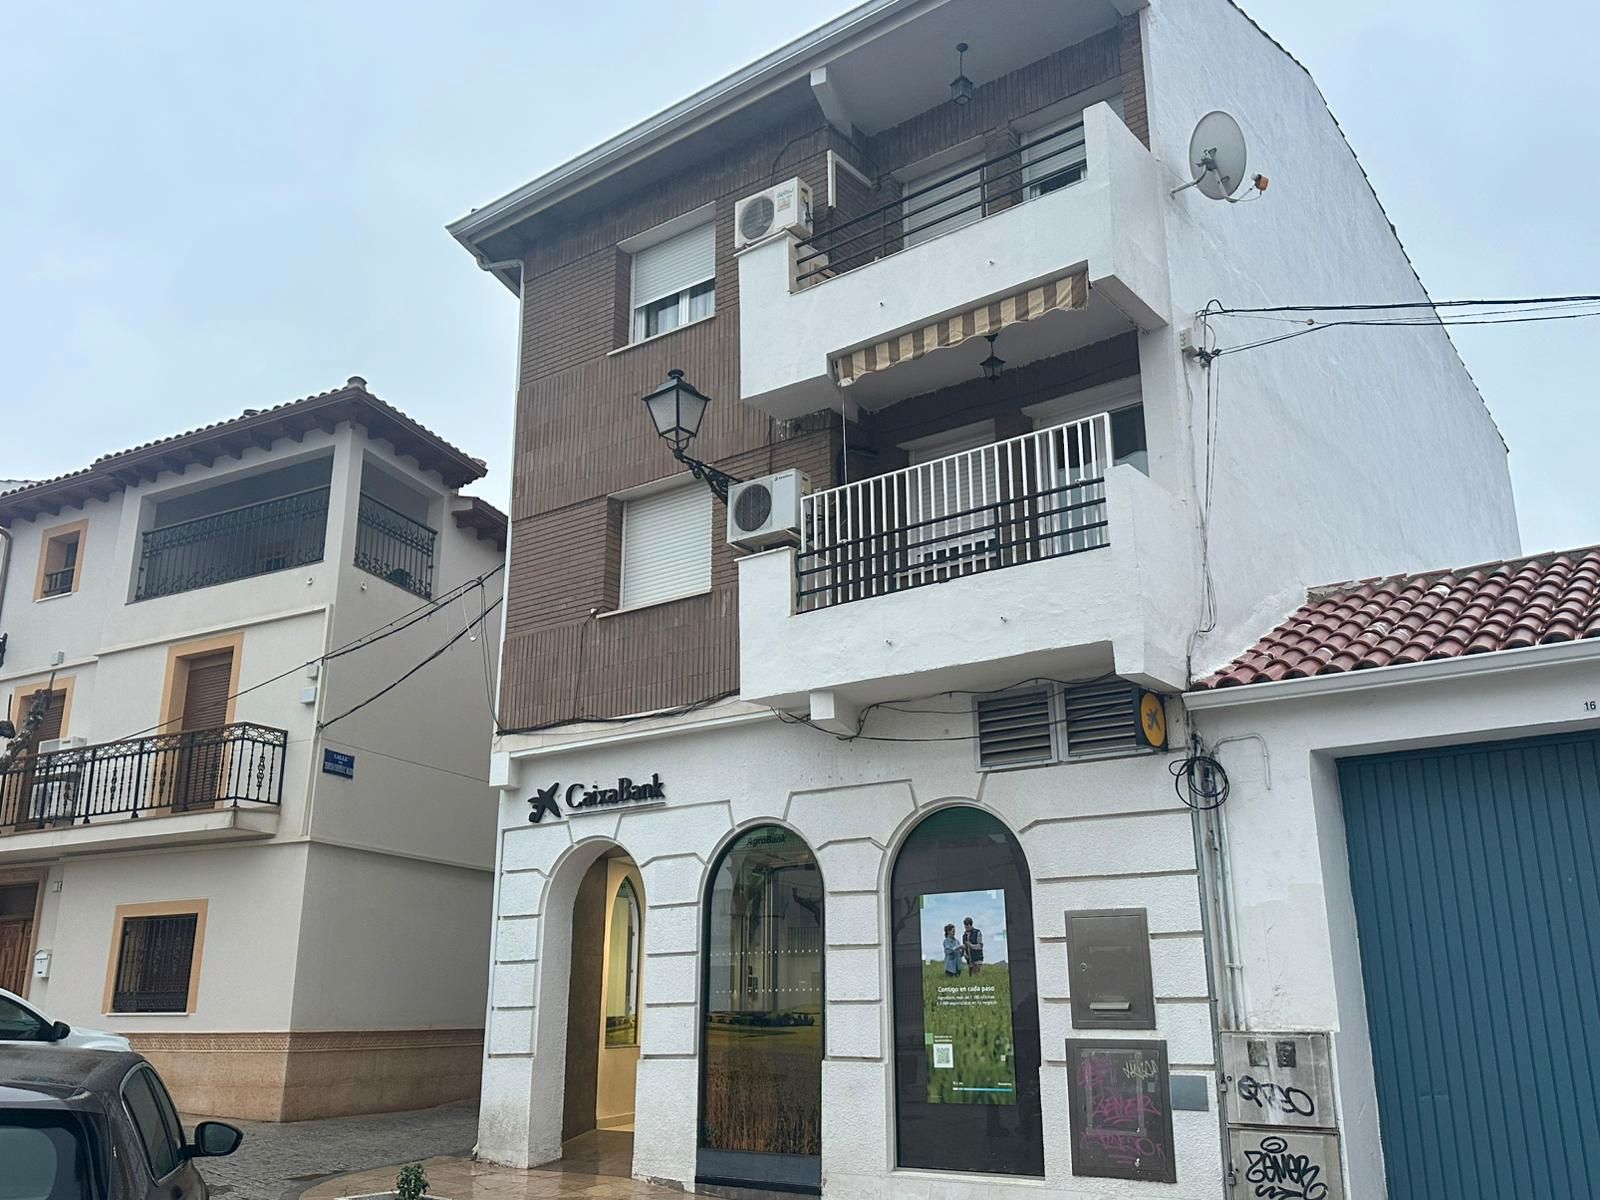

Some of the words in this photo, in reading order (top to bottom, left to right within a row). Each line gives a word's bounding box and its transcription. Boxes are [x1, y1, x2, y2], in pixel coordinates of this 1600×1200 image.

[1583, 700, 1597, 711] 16
[565, 773, 665, 809] CaixaBank
[746, 834, 786, 847] AgroBank
[937, 986, 959, 994] Contigo
